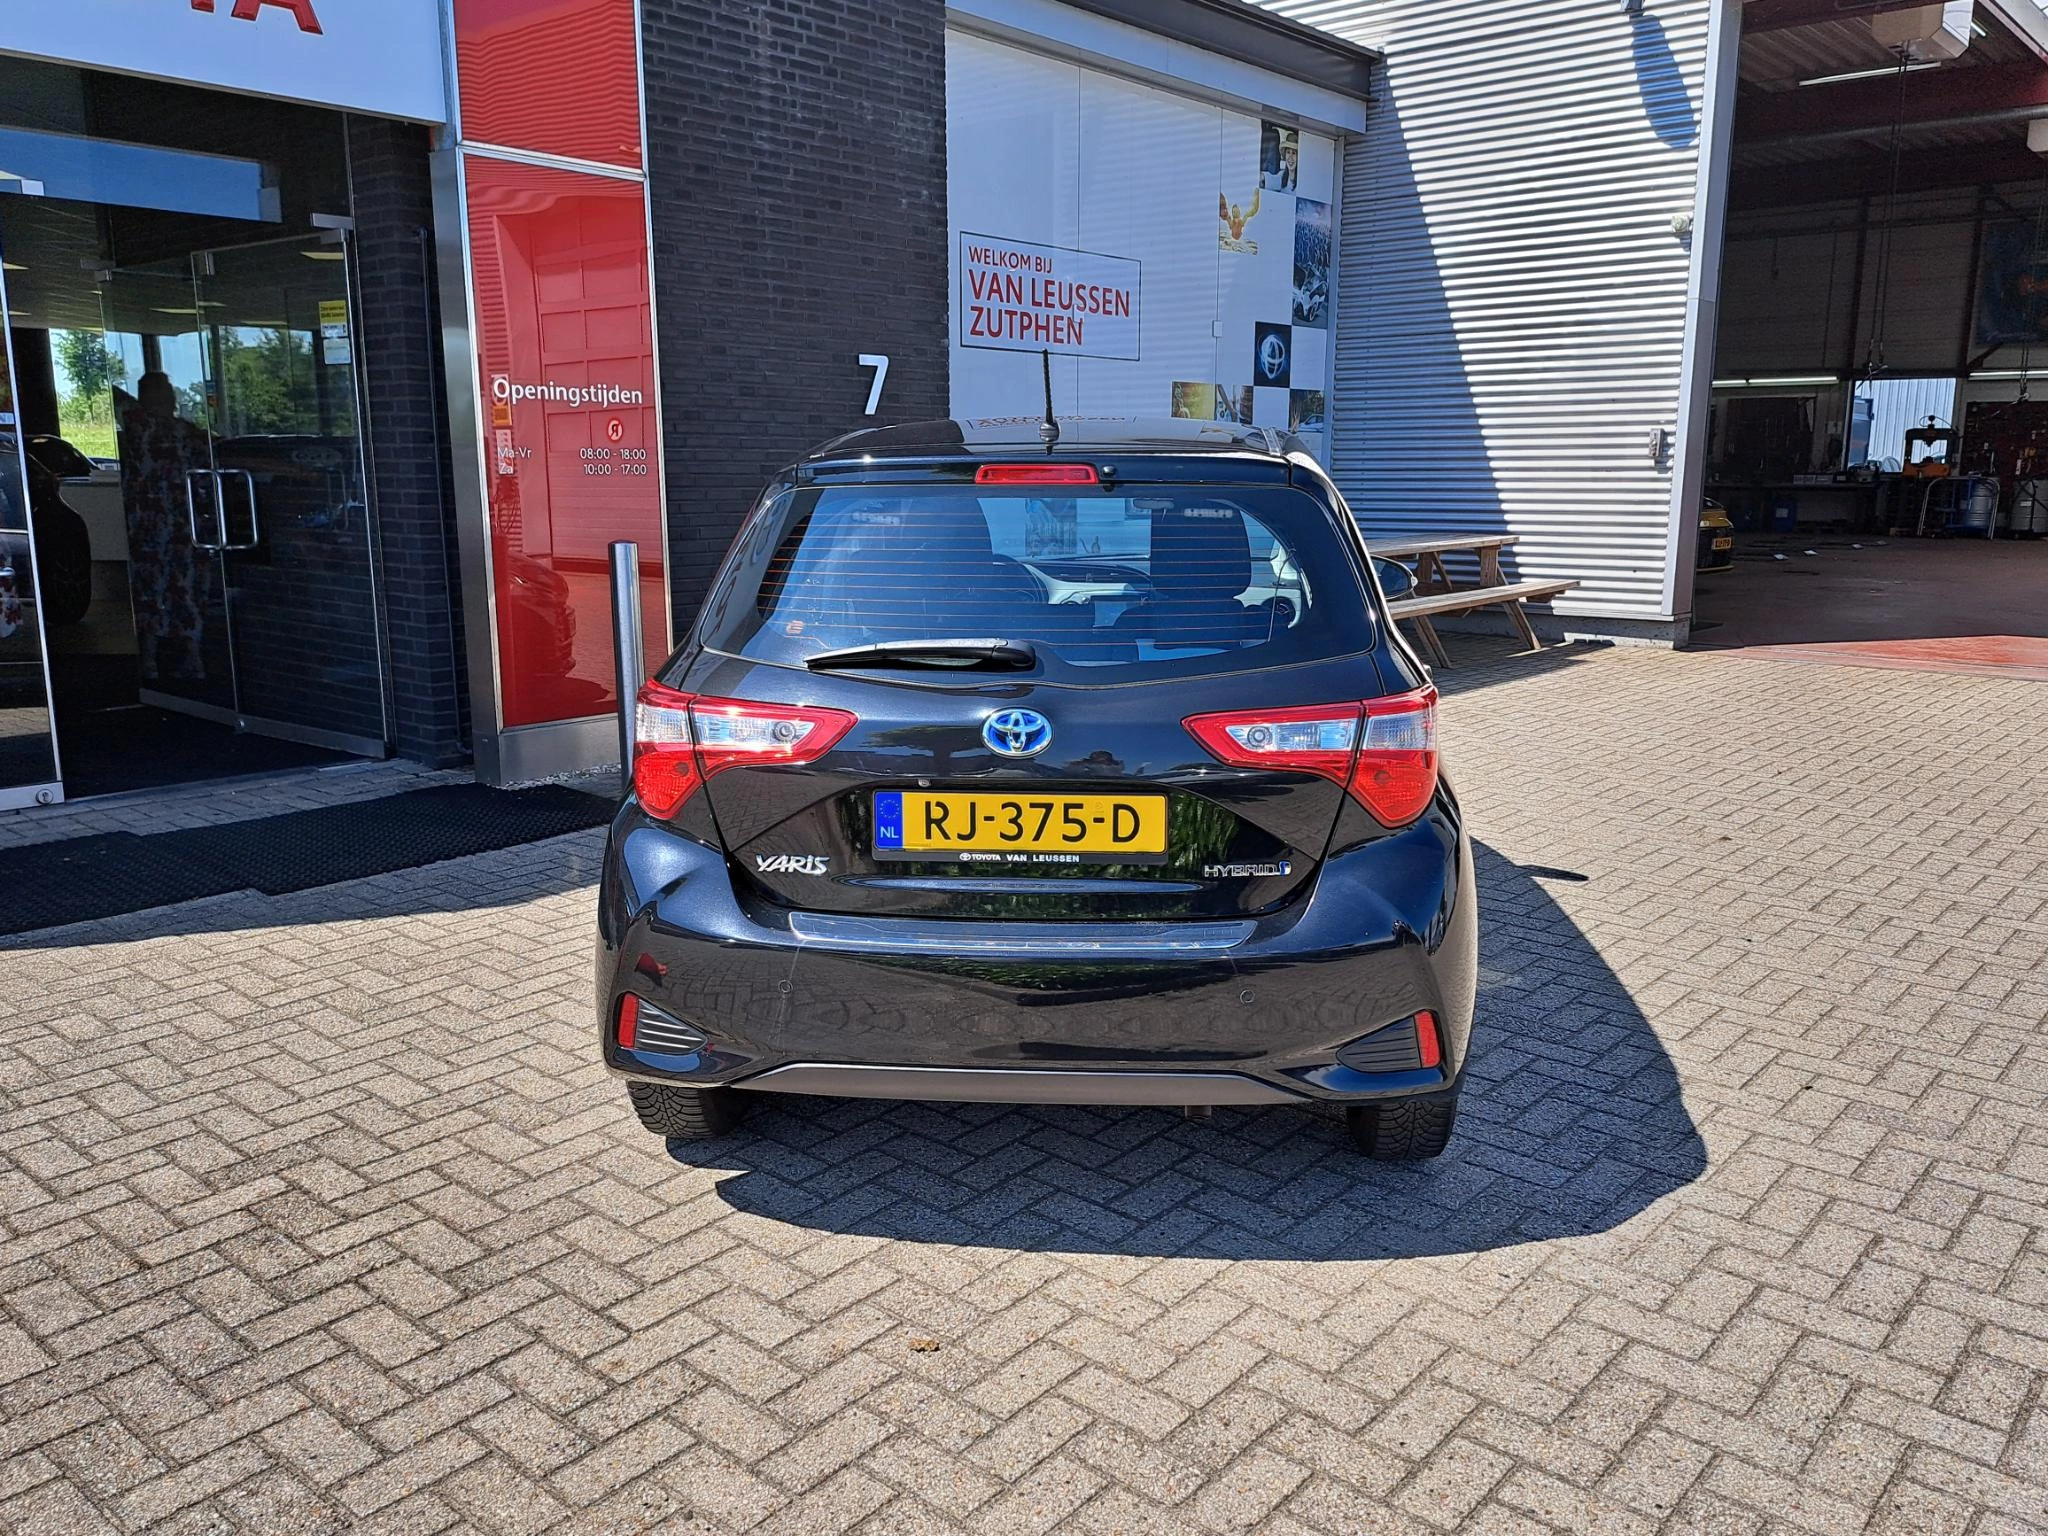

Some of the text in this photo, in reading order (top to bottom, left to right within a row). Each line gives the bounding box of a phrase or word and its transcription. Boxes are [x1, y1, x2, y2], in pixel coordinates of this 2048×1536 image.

[968, 245, 1052, 274] WELKOM BIJ
[968, 269, 1130, 317] VAN LEUSSEN
[969, 305, 1084, 346] ZUTPHEN
[493, 378, 643, 408] Openingstijden
[858, 353, 889, 415] 7
[498, 447, 532, 459] Ma-Vr
[579, 447, 611, 460] 08:00
[620, 448, 646, 460] 18:00
[583, 463, 612, 475] 10:00
[620, 464, 647, 475] 17:00
[879, 826, 900, 839] NL
[924, 800, 1141, 844] RJ-375-D
[756, 854, 830, 875] YARIS
[971, 853, 1080, 863] TOYOTA VAN LEUSSEN
[1204, 864, 1278, 878] HYBRID
